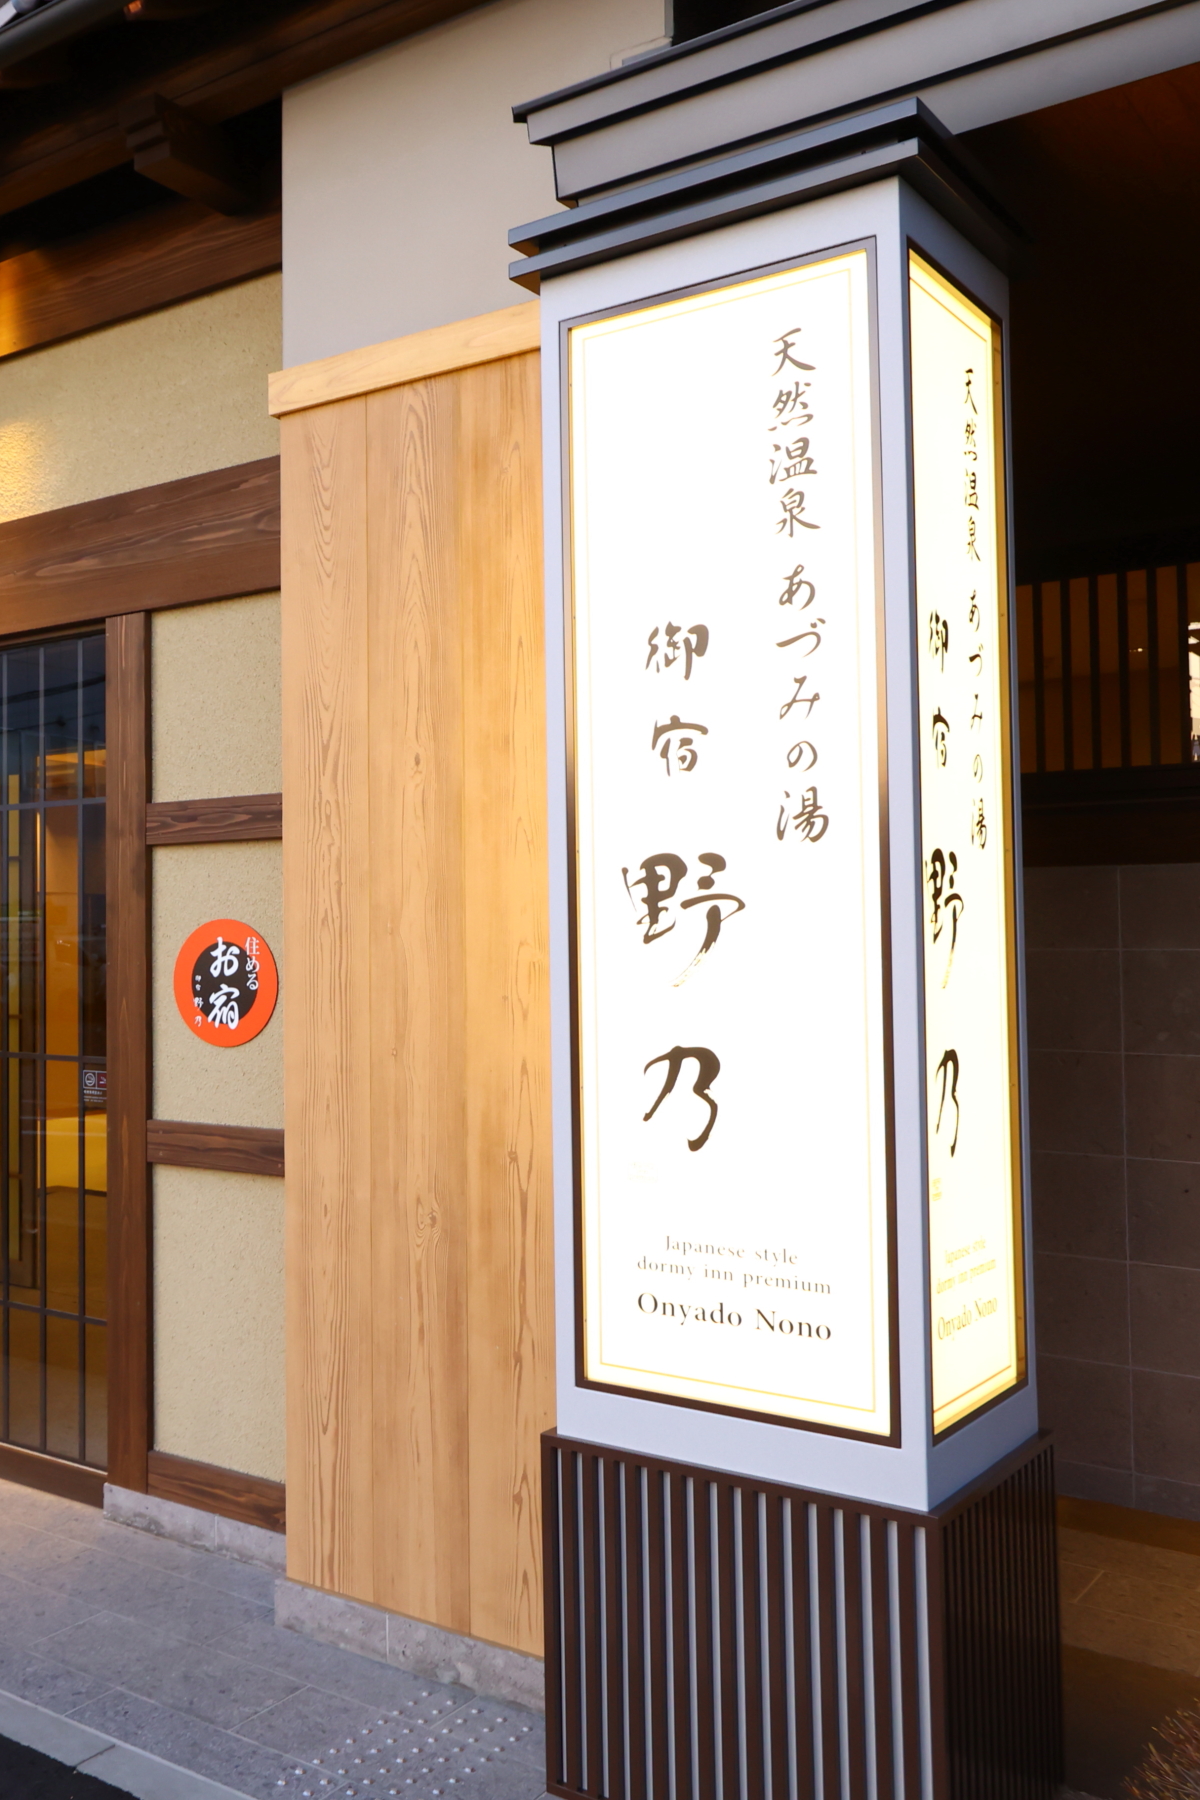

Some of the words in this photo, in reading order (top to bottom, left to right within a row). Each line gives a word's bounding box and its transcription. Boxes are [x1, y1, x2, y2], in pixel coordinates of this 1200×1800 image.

[767, 327, 822, 538] 天然温泉
[963, 368, 982, 562] 天然温泉
[645, 620, 711, 778] 御宿
[775, 563, 830, 844] あづみの湯
[928, 610, 951, 769] 御宿
[968, 589, 988, 850] あづみの湯
[207, 936, 241, 1030] お宿
[245, 936, 261, 991] 住める
[620, 851, 747, 1153] 野乃
[926, 847, 965, 1158] 野乃
[637, 1256, 695, 1281] dormy
[703, 1264, 734, 1282] inn
[743, 1269, 833, 1296] premium
[637, 1292, 743, 1326] Onyado
[755, 1308, 833, 1341] Nono
[664, 1235, 745, 1261] Japanese
[754, 1244, 799, 1268] style
[936, 1304, 973, 1341] Onyado
[974, 1297, 998, 1322] Nono
